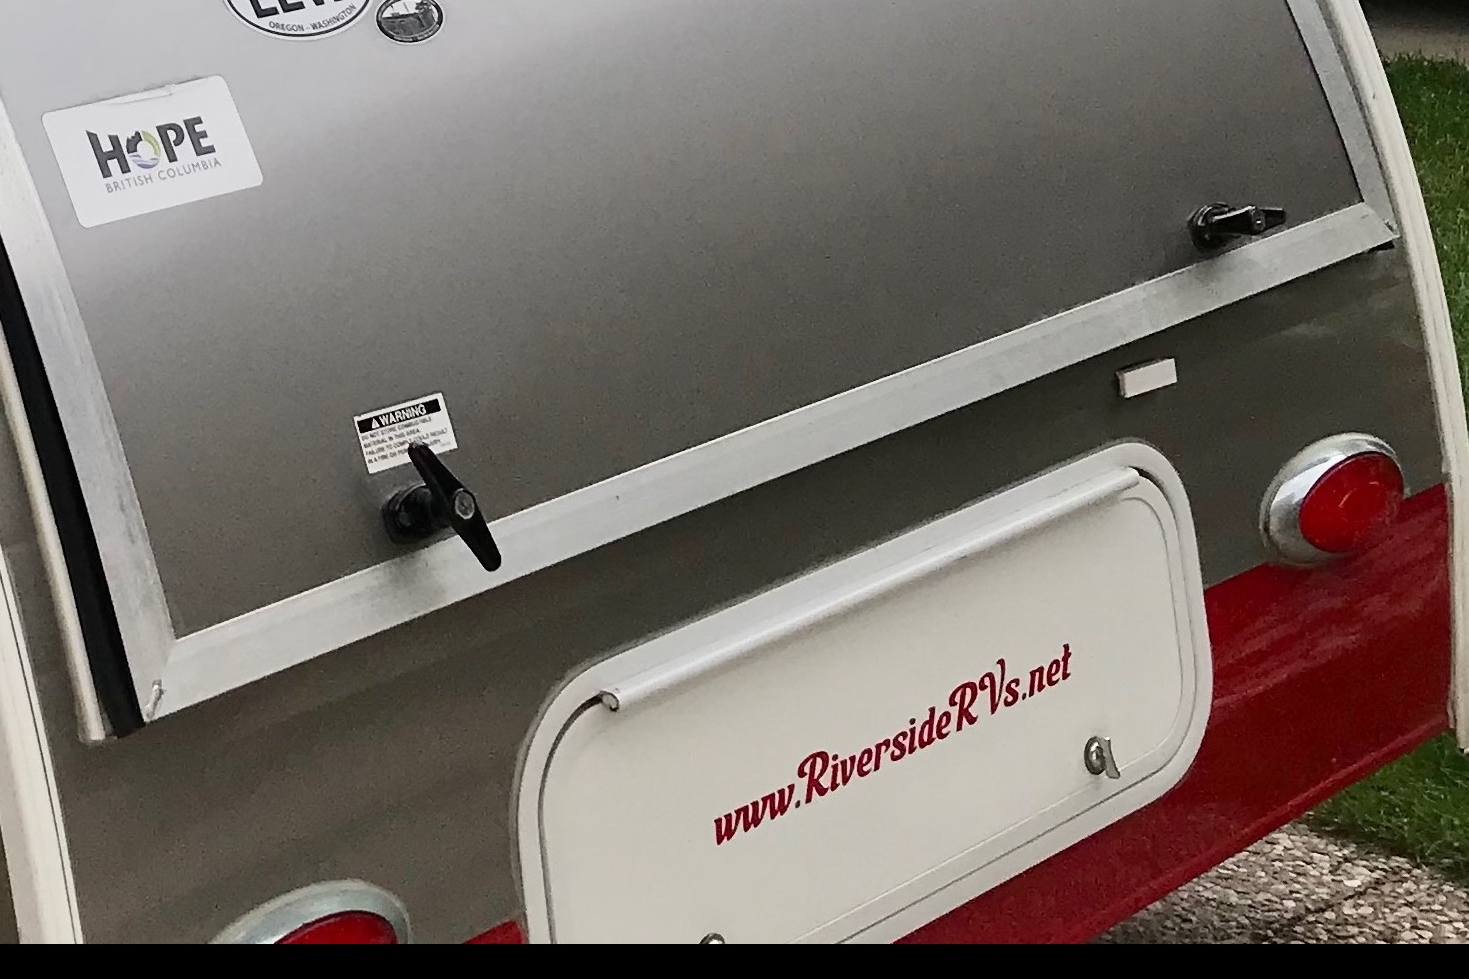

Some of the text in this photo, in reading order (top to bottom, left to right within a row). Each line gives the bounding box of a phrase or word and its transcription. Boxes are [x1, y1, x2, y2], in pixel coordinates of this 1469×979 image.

[268, 20, 305, 32] OREGON
[309, 3, 356, 32] WASHINGTON
[85, 116, 216, 179] HOPE
[106, 157, 222, 193] BRITISH COLUMBIA
[379, 404, 427, 426] WARNING
[713, 643, 1073, 846] www.RiversideRVs.net
